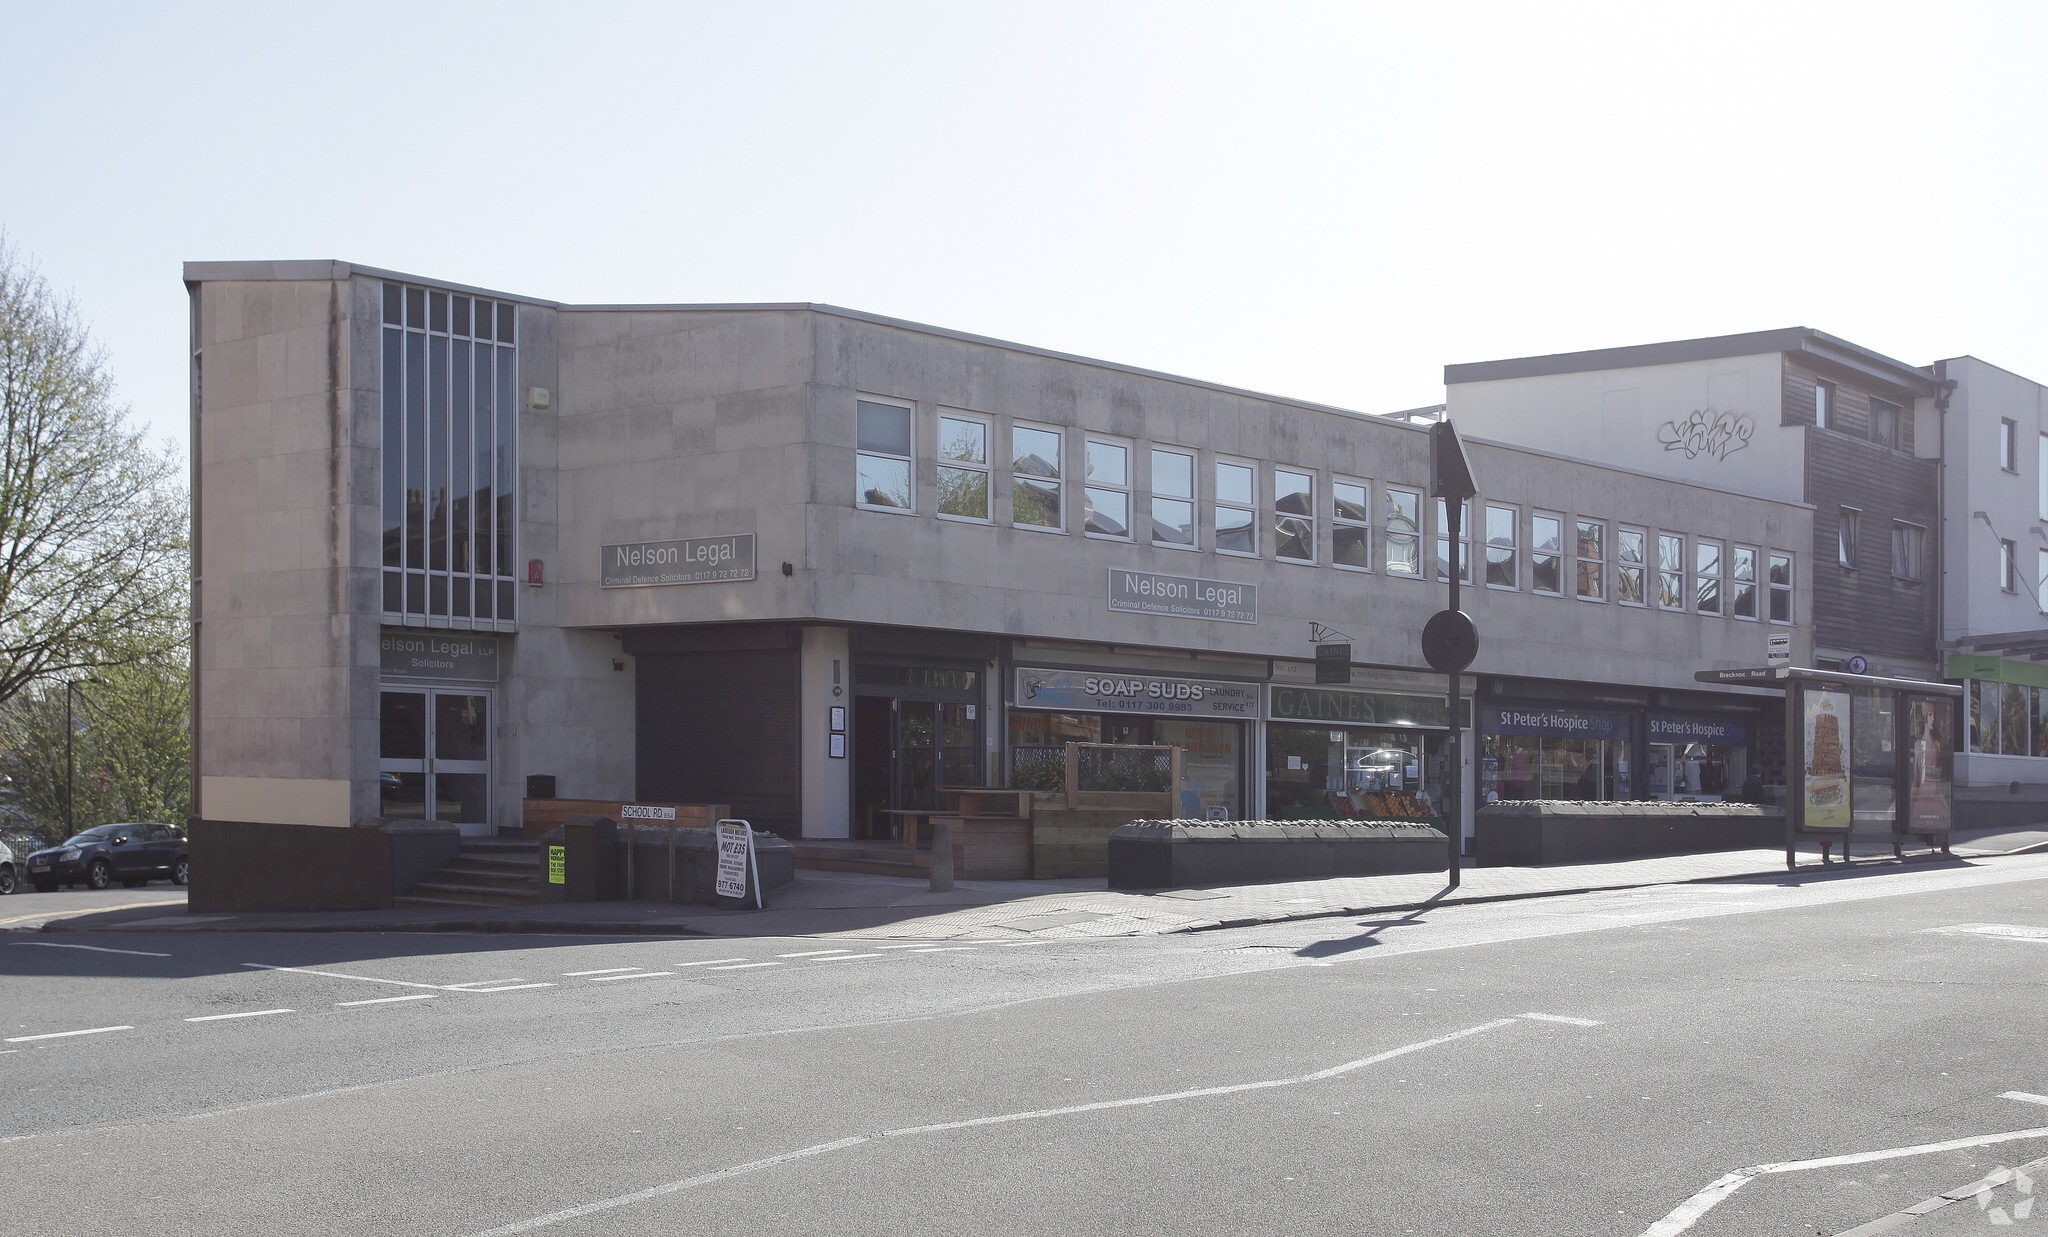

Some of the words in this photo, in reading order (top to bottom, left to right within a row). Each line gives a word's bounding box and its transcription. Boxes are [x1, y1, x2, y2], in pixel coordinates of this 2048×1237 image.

[617, 545, 678, 567] Nelson
[686, 538, 736, 566] Legal
[605, 576, 631, 585] Criminal
[633, 574, 659, 583] Defence
[661, 573, 691, 582] Solicitors
[695, 571, 710, 580] 0117
[712, 571, 717, 579] 9
[719, 570, 727, 578] 72
[729, 569, 738, 577] 72
[740, 568, 749, 577] 72
[1125, 574, 1188, 599] Nelson
[1196, 581, 1242, 608] Legal
[1112, 598, 1140, 609] Criminal
[1141, 601, 1169, 612] Defence
[1170, 604, 1200, 615] Solicitors
[1203, 608, 1219, 616] 0117
[1221, 609, 1226, 617] 9
[1227, 609, 1235, 618] 72
[1237, 610, 1245, 619] 72
[1246, 611, 1254, 620] 72
[381, 637, 424, 652] elson
[431, 639, 473, 658] Legal
[478, 648, 494, 656] LLP
[411, 658, 454, 669] Solicitors
[1287, 665, 1297, 673] 172
[1085, 676, 1144, 698] SOAP
[1148, 681, 1205, 701] SUDS
[1210, 687, 1245, 698] LAUNDRY
[1095, 698, 1115, 708] Tel:
[1119, 699, 1143, 710] 0117
[1147, 701, 1165, 711] 300
[1168, 701, 1193, 712] 9983
[1212, 702, 1245, 712] SERVICE
[1277, 689, 1376, 720] GAINES
[1501, 711, 1511, 725] St
[1513, 712, 1548, 727] Peter's
[1550, 715, 1588, 732] Hospice
[1590, 716, 1613, 733] Shop
[1651, 720, 1660, 733] St
[1661, 721, 1691, 734] Peter's
[1692, 722, 1725, 738] Hospice
[623, 806, 651, 818] SCHOOL
[721, 841, 734, 853] MOT
[718, 880, 728, 889] 977
[729, 882, 744, 892] 6740
